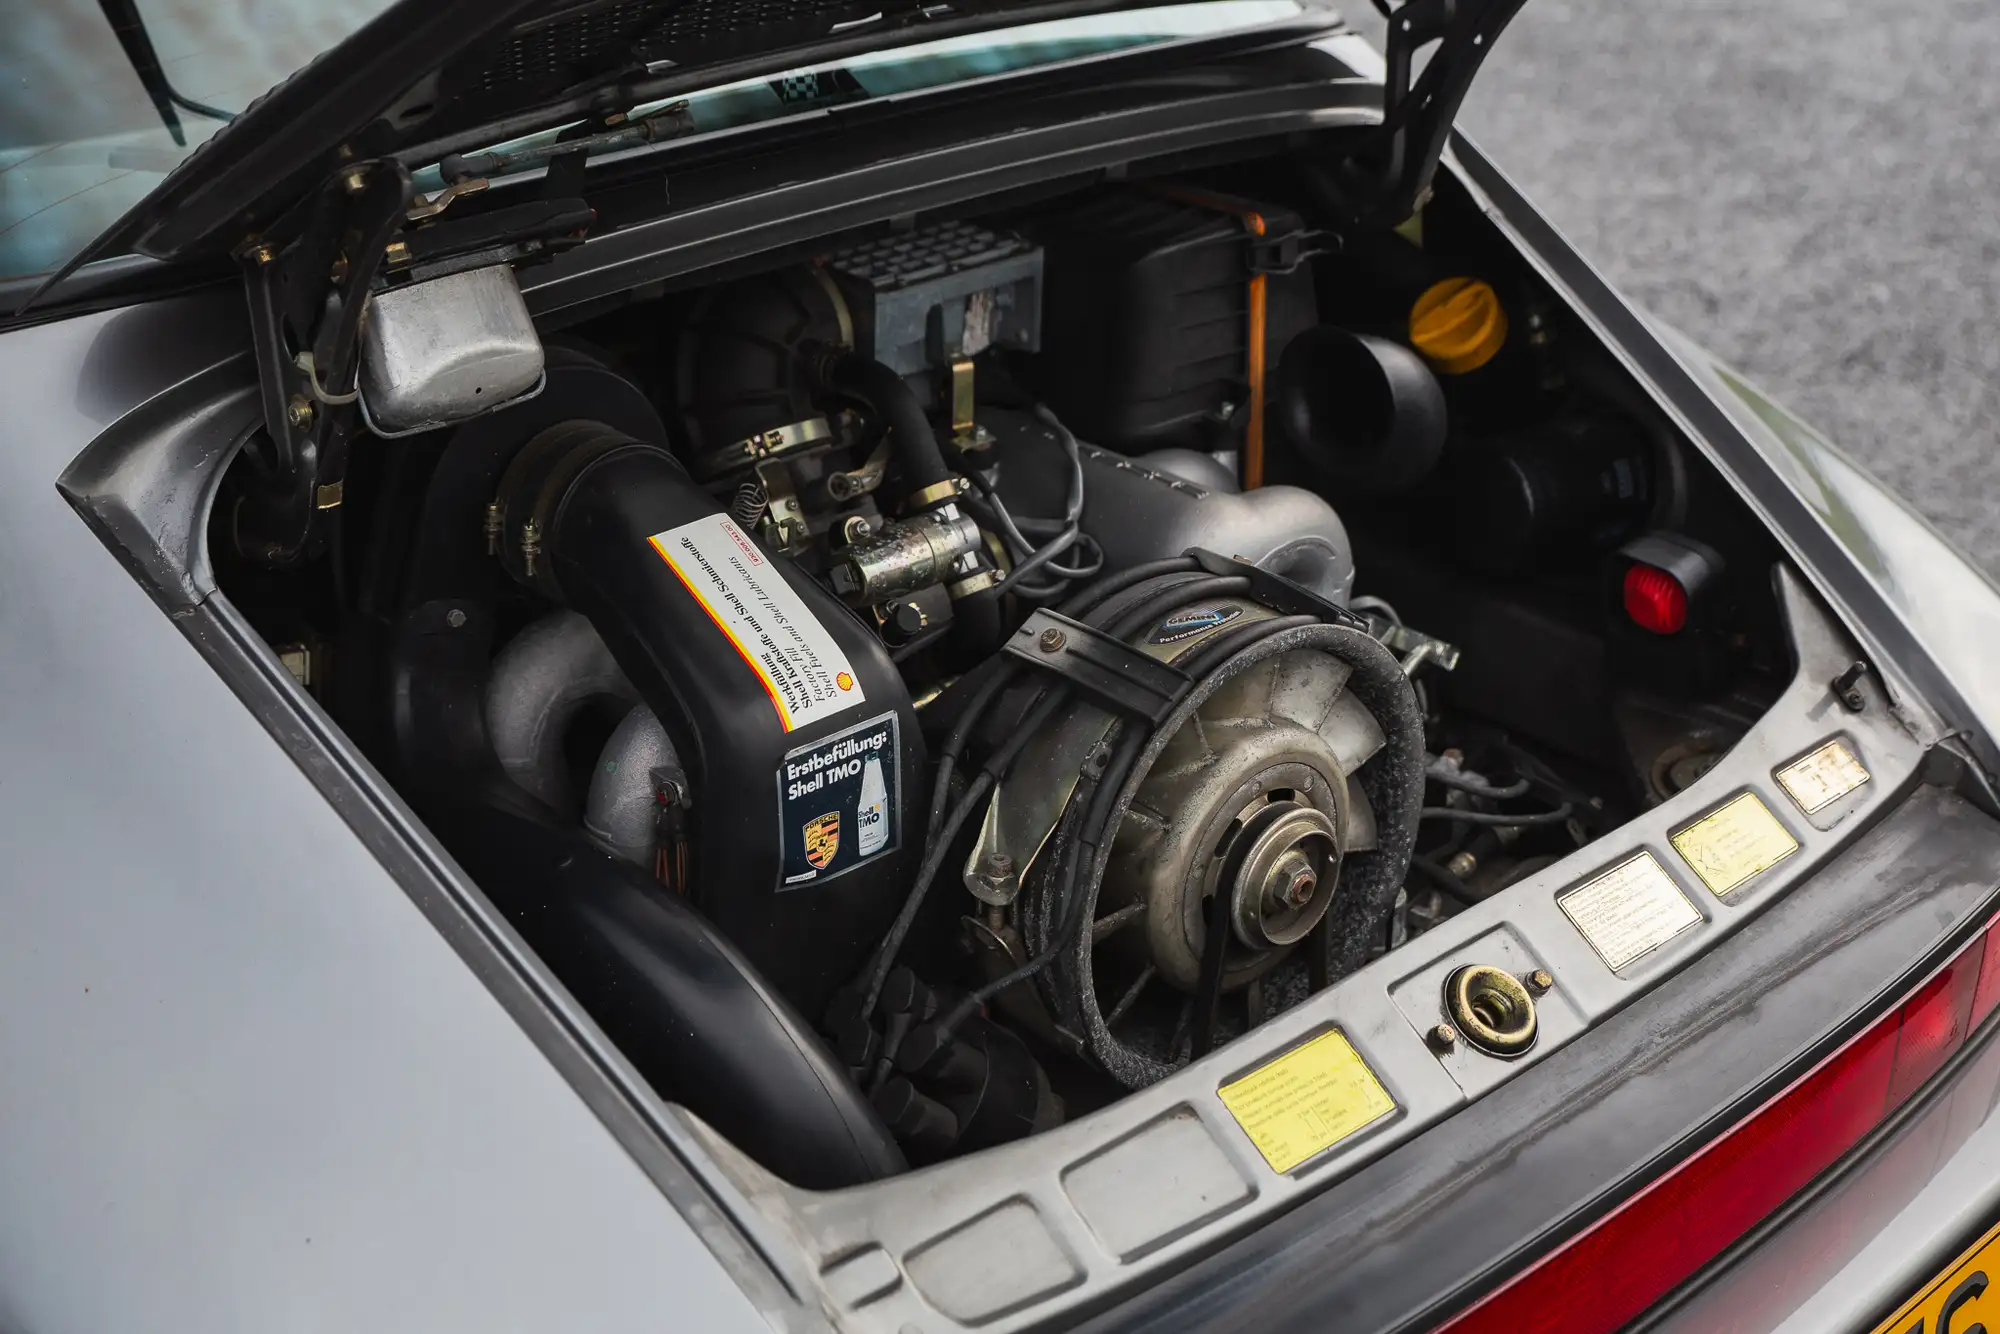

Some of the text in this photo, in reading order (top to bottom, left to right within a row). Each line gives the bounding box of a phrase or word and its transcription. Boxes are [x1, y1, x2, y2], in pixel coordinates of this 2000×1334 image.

[681, 536, 813, 709] Shell Kraftstoffe und Shell Schmierstoffe
[728, 556, 838, 698] Shell Fuels and Shell Lubricants
[760, 652, 800, 714] Werkfüllung
[784, 647, 825, 702] Factory Fill
[787, 731, 888, 781] Erstbefüllung:
[788, 758, 862, 801] Shell TMO
[804, 812, 838, 832] PORSCHE
[858, 805, 874, 819] Shell
[858, 812, 880, 829] TMO
